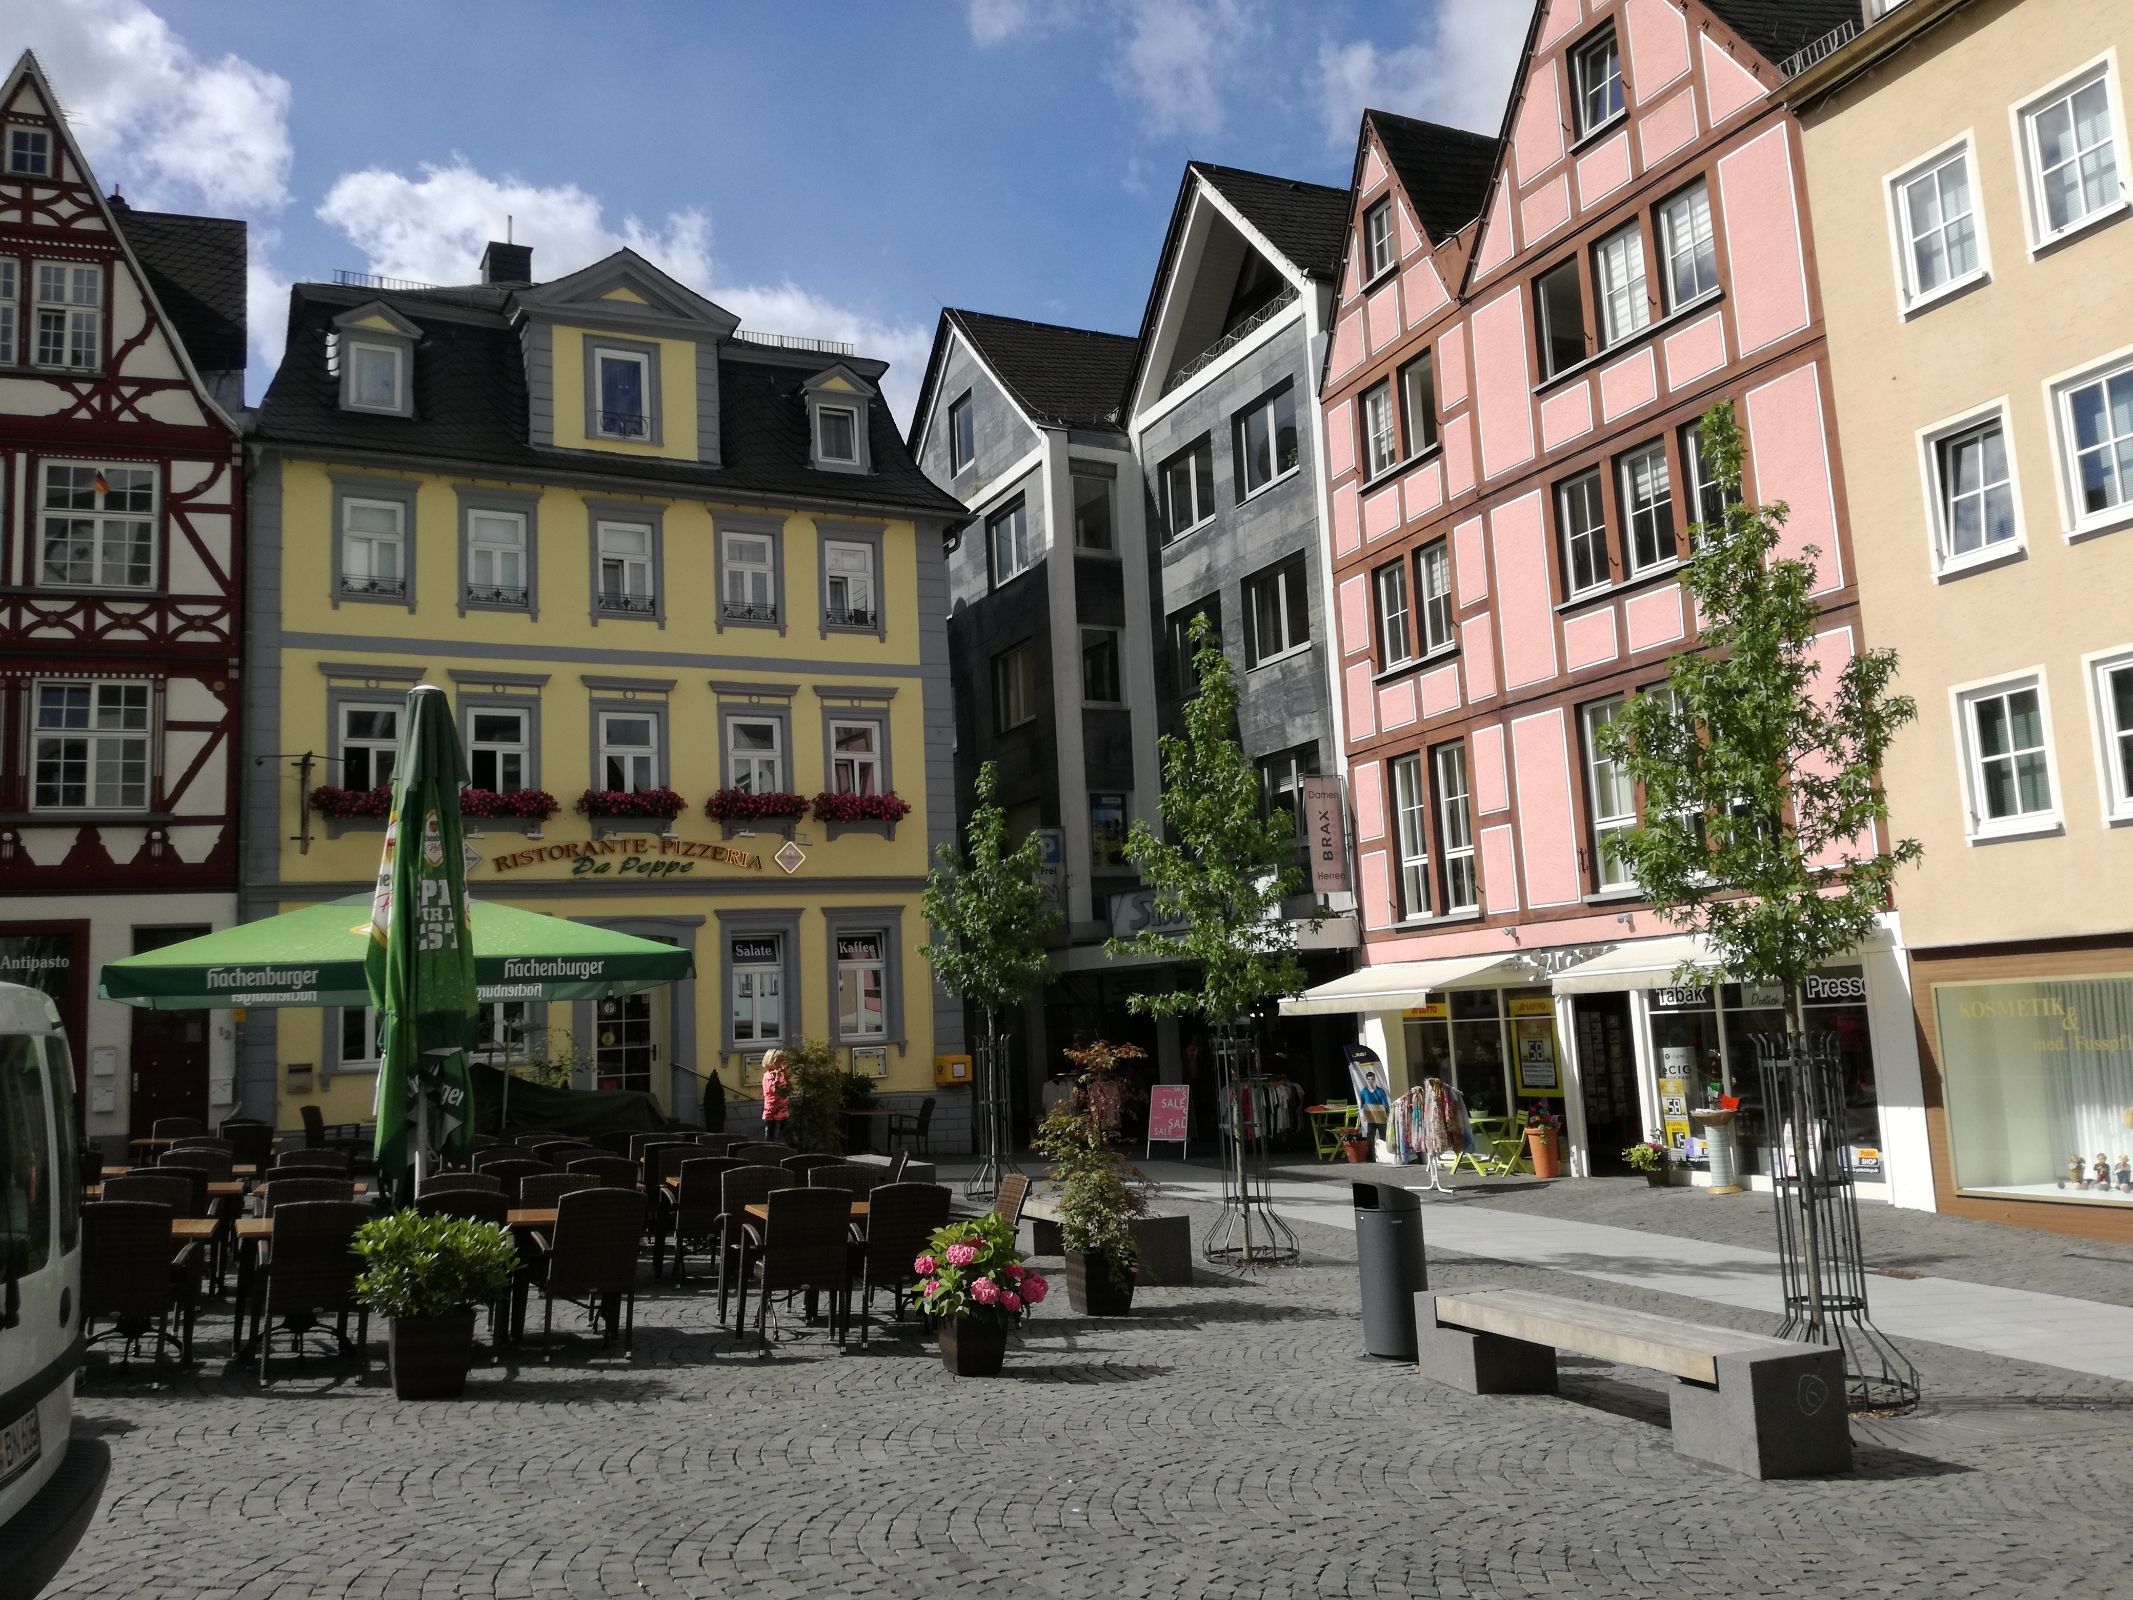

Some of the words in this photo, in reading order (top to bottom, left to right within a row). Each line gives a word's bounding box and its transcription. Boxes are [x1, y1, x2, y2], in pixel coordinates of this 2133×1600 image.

[1308, 790, 1339, 800] Damen
[1318, 809, 1334, 861] BRAX
[572, 856, 612, 875] Da
[619, 857, 695, 877] Peppe
[1041, 866, 1057, 875] Frei
[1317, 872, 1346, 881] Herren
[735, 944, 773, 957] Salate
[838, 941, 876, 954] Kaffee
[0, 954, 70, 972] Antipasto
[1656, 986, 1708, 1006] Tabak
[1960, 998, 2065, 1019] KOSMETIK
[2063, 1007, 2080, 1031] &
[219, 1026, 232, 1040] 12
[1161, 1099, 1185, 1109] SALE
[1667, 1098, 1682, 1116] 58
[1154, 1127, 1173, 1136] SALE
